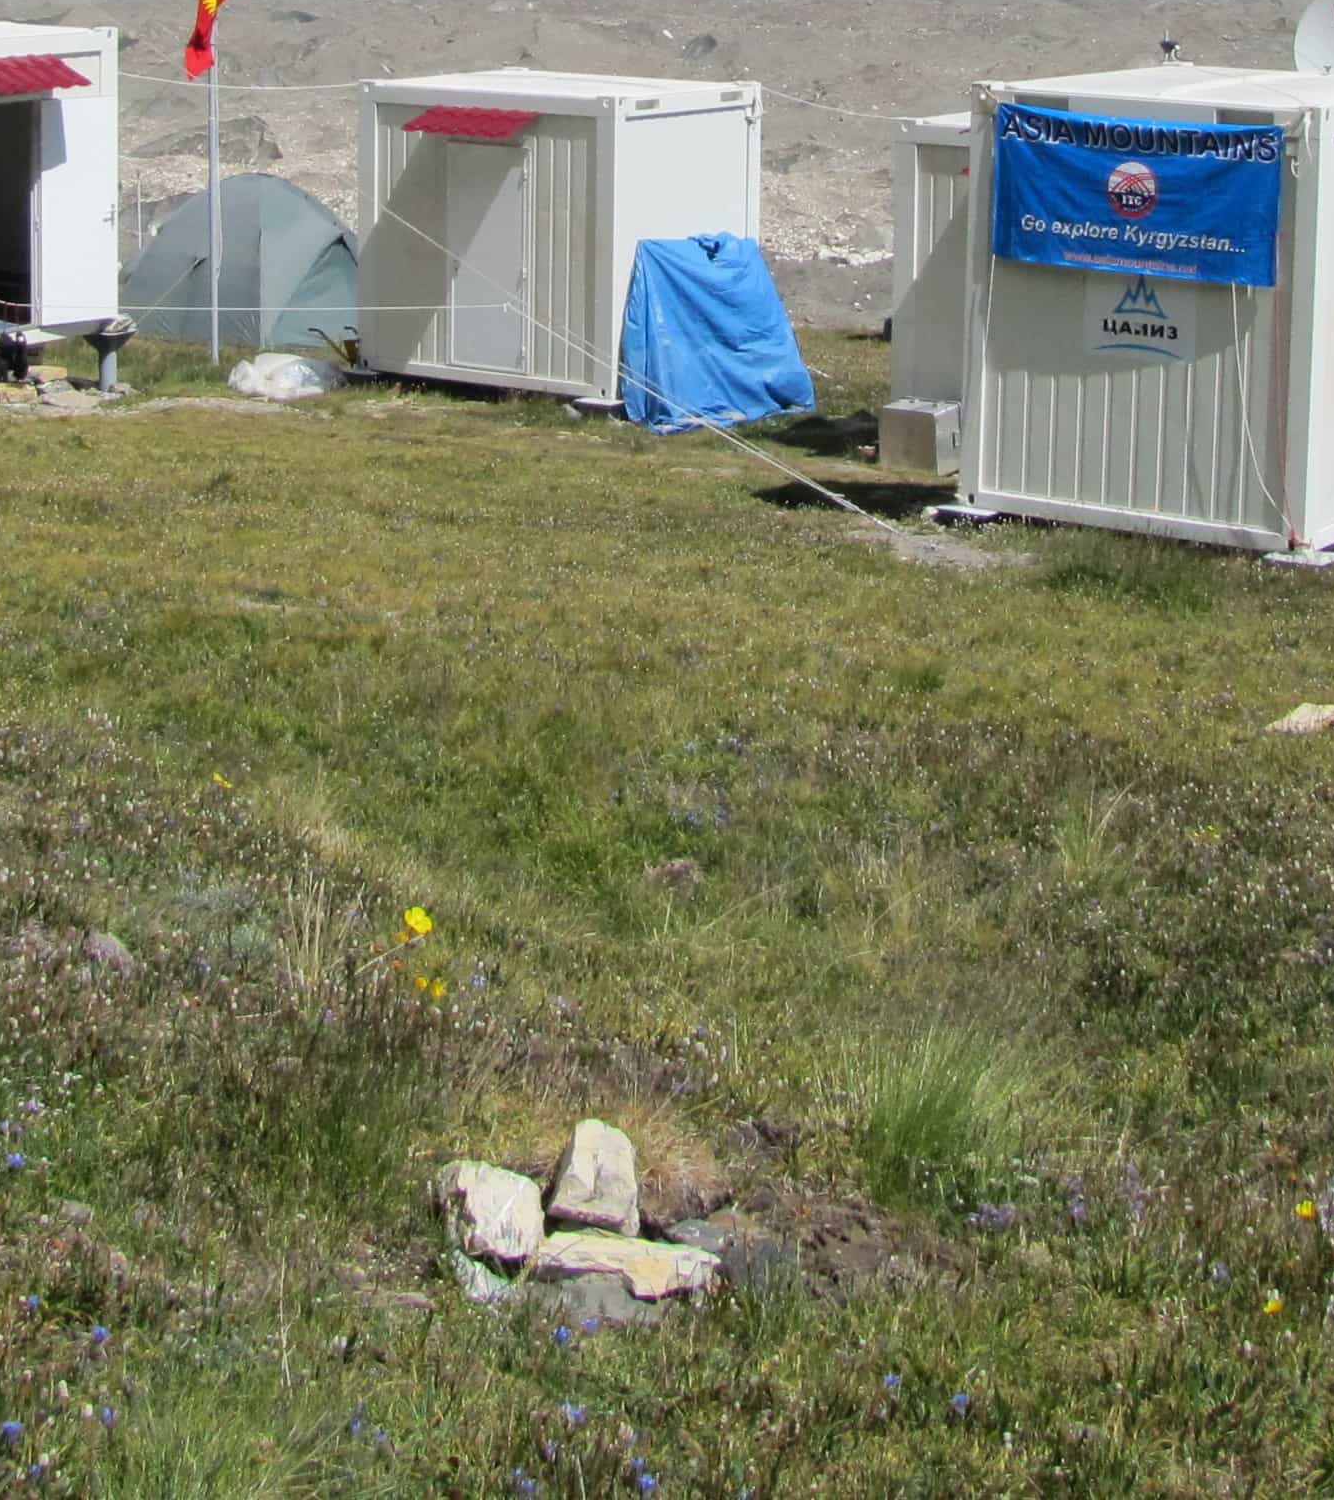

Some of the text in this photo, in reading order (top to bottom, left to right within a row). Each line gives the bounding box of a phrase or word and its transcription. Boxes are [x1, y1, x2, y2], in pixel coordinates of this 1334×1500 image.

[1002, 111, 1277, 163] ASIA MOUNTAINS
[1121, 194, 1143, 206] ITC
[1021, 214, 1245, 253] Go explore Kyrgyzstan...
